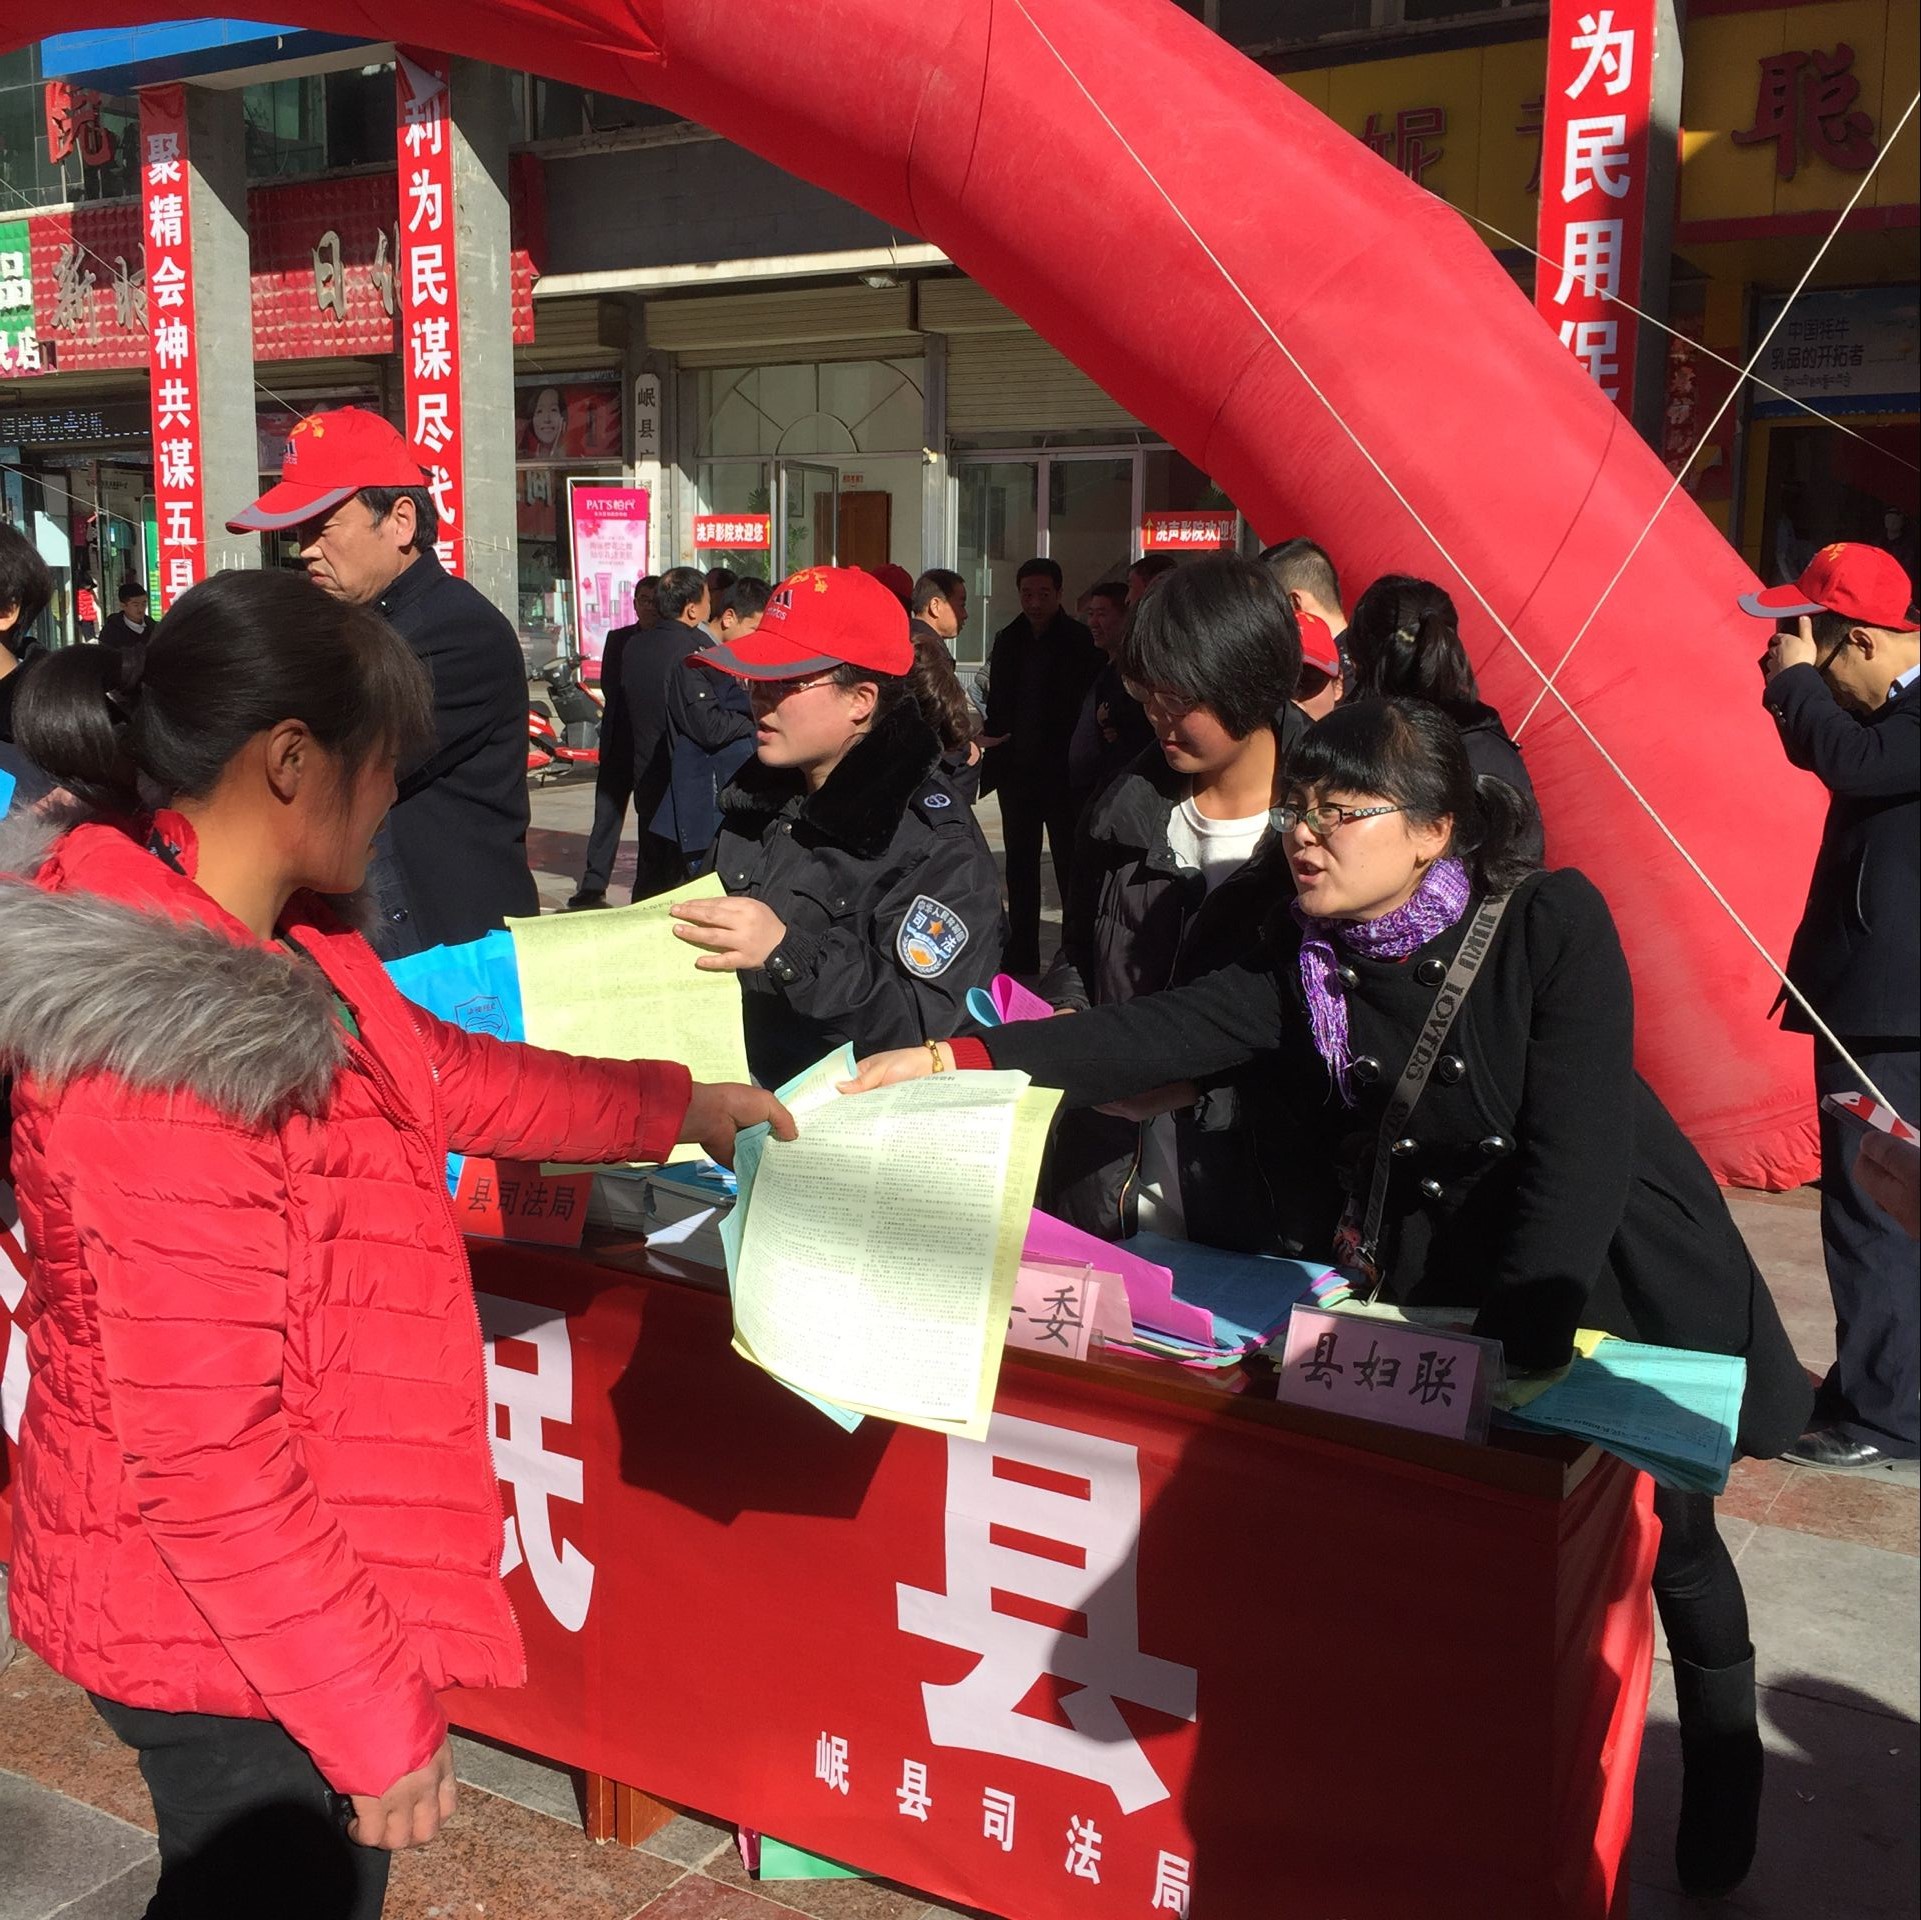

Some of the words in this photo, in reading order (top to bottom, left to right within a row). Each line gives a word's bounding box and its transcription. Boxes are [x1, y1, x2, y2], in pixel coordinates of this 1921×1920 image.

[468, 1177, 576, 1222] 县司法局
[1008, 1285, 1084, 1348] 委
[1299, 1332, 1458, 1408] 县妇联
[815, 1731, 1191, 1919] 岷县司法局
